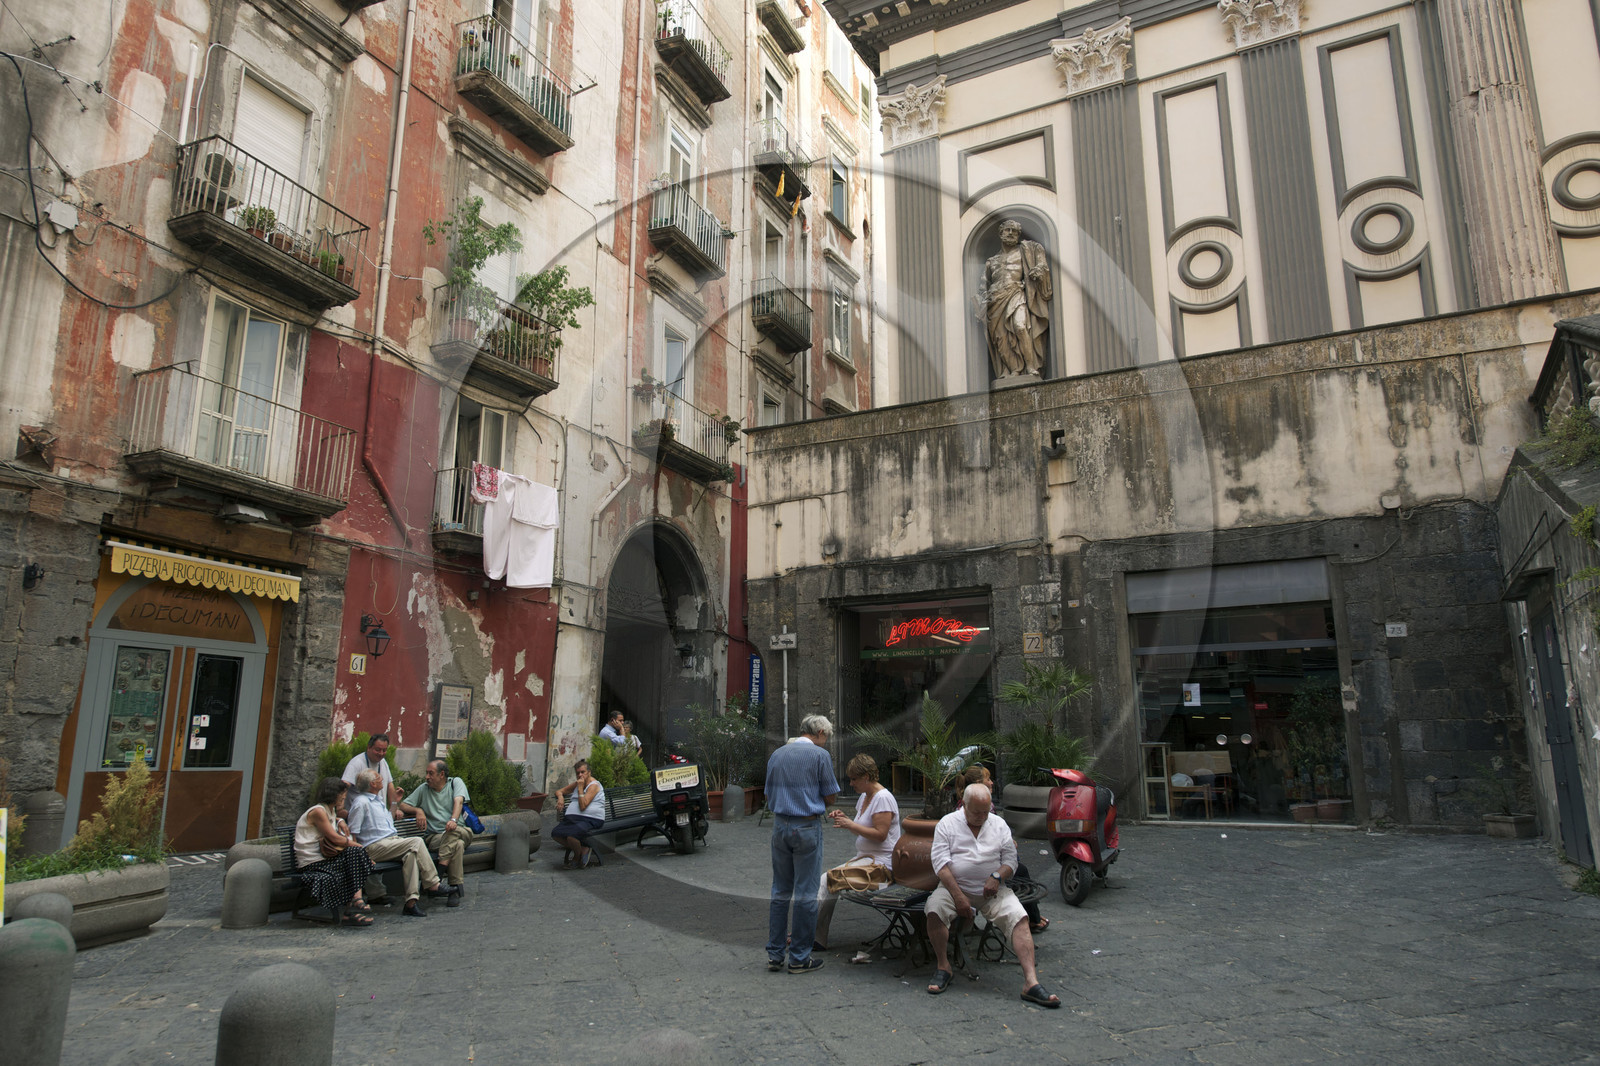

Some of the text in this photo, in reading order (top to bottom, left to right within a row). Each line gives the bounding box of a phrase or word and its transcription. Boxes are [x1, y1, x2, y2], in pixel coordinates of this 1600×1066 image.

[122, 552, 169, 577] PIZZERIA
[172, 561, 236, 589] FRIGGITORIA
[243, 574, 293, 598] DECUMANI
[138, 601, 241, 631] DECUMANI
[1390, 626, 1403, 635] 73
[1026, 635, 1041, 650] 72
[872, 650, 889, 658] WWW.
[892, 649, 926, 657] LIMONCELLO
[351, 656, 364, 671] 61
